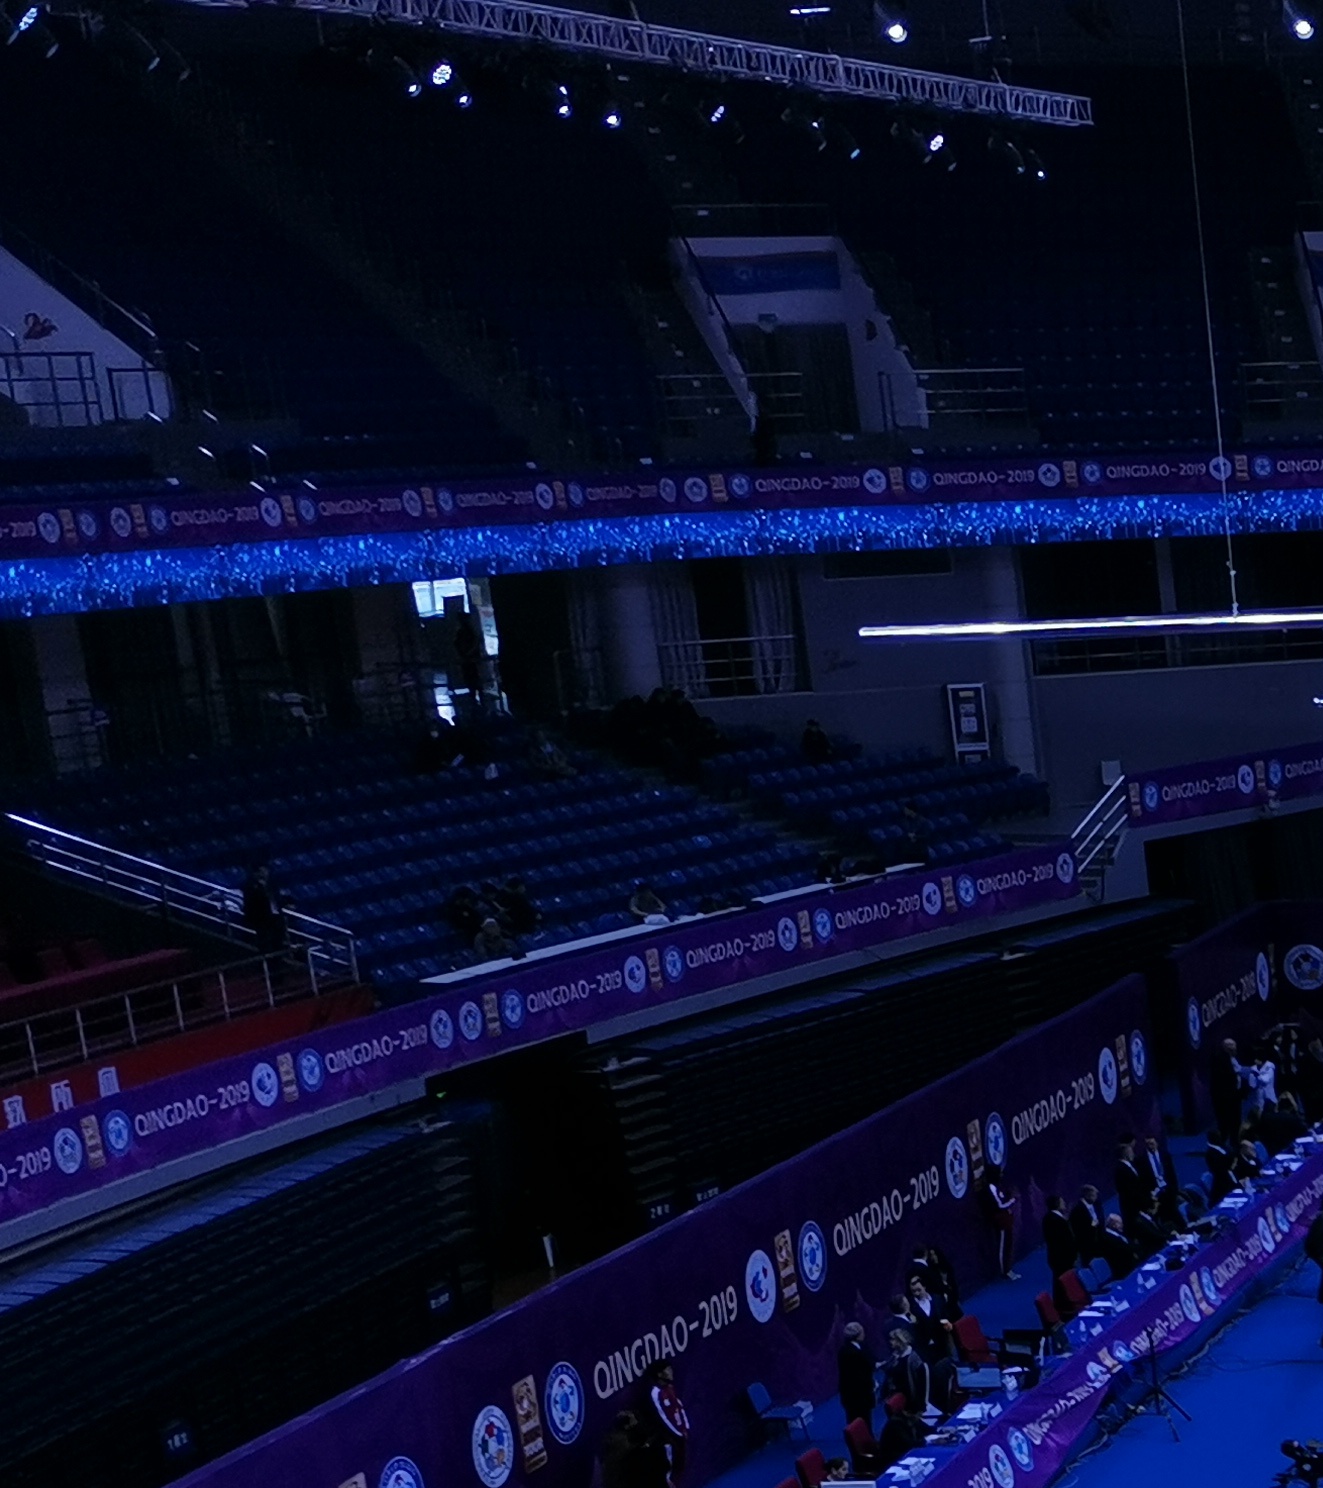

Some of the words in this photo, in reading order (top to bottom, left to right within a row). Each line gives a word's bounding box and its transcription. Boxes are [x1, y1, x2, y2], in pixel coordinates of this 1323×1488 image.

[976, 862, 1056, 895] QINGDAO-2019
[834, 894, 921, 930] QINGDAO-2019
[685, 928, 777, 969] QINGDAO-2019
[526, 967, 623, 1016] QINGDAO-2019
[324, 1023, 429, 1075] QINGDAO-2019
[133, 1080, 251, 1137] QINGDAO-2019
[1011, 1072, 1095, 1145] QINGDAO-2019
[832, 1164, 941, 1257] QINGDAO-2019
